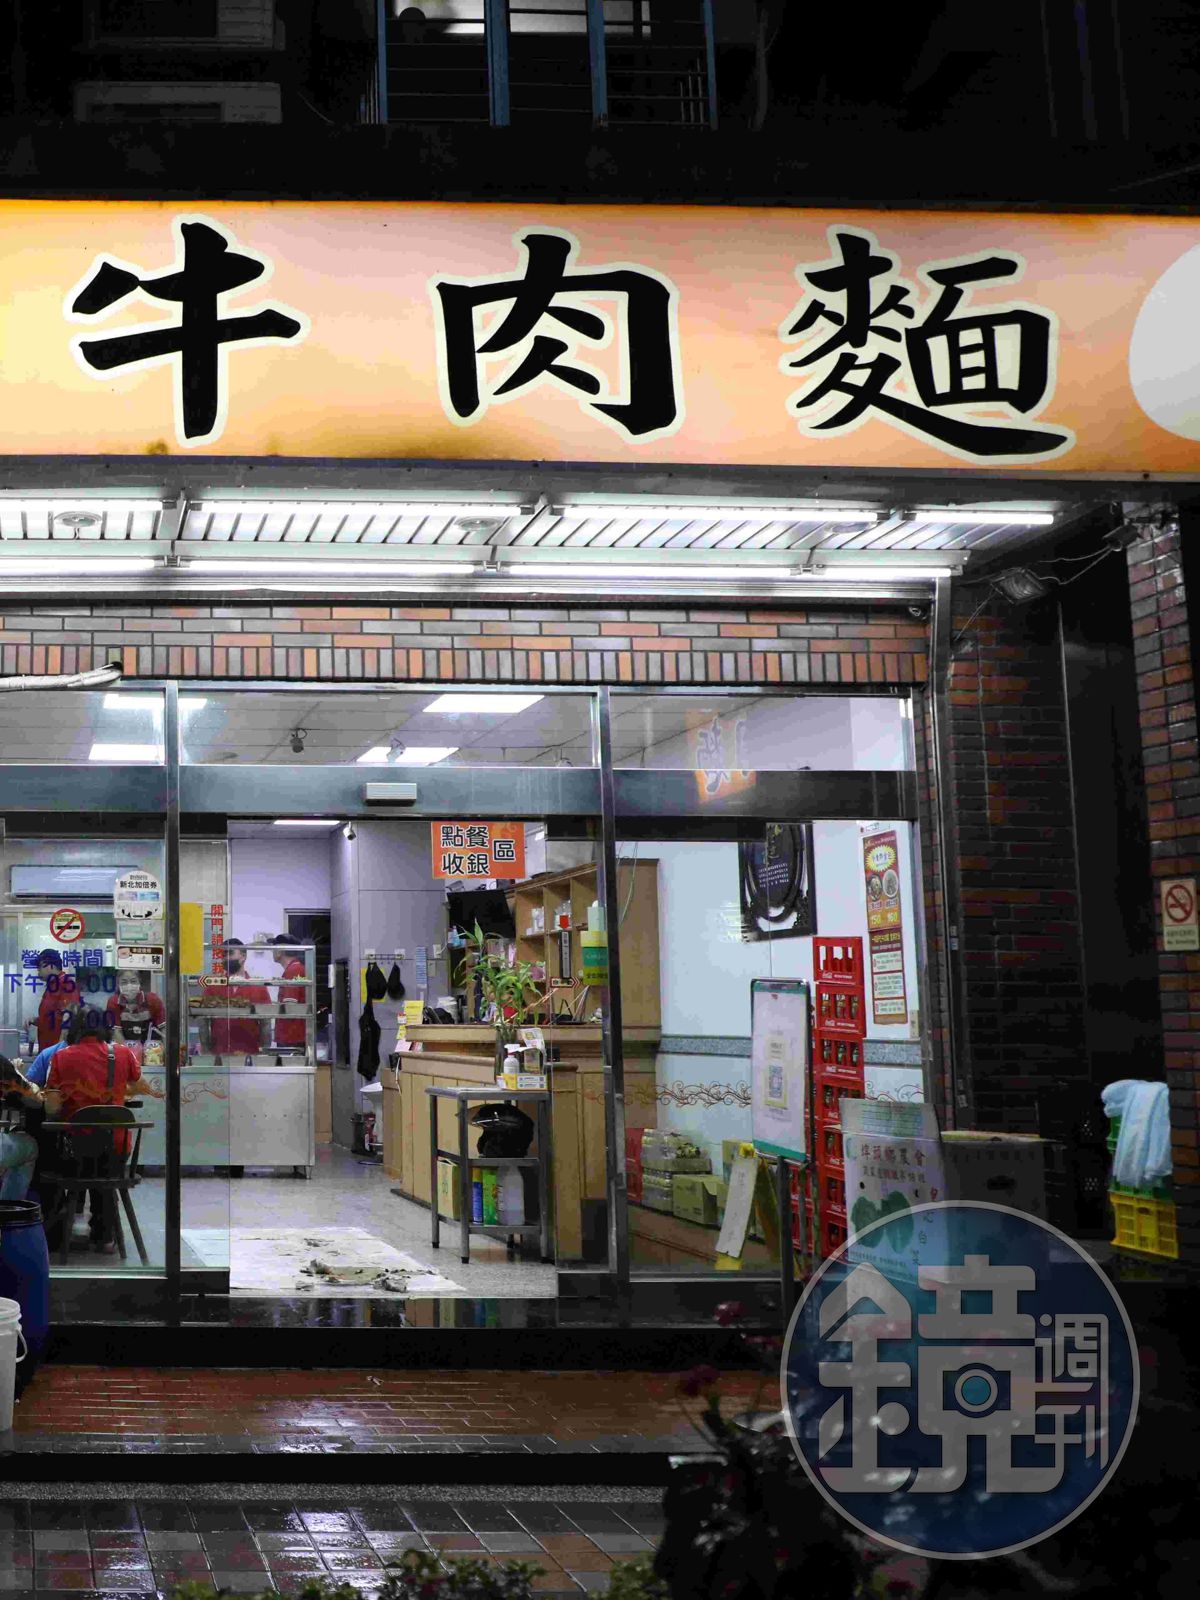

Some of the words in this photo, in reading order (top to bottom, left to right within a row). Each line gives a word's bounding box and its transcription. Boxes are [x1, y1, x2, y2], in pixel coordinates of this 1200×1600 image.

[441, 826, 489, 848] 點餐
[493, 839, 516, 862] 區
[441, 853, 489, 875] 收銀
[46, 1009, 116, 1031] 1200
